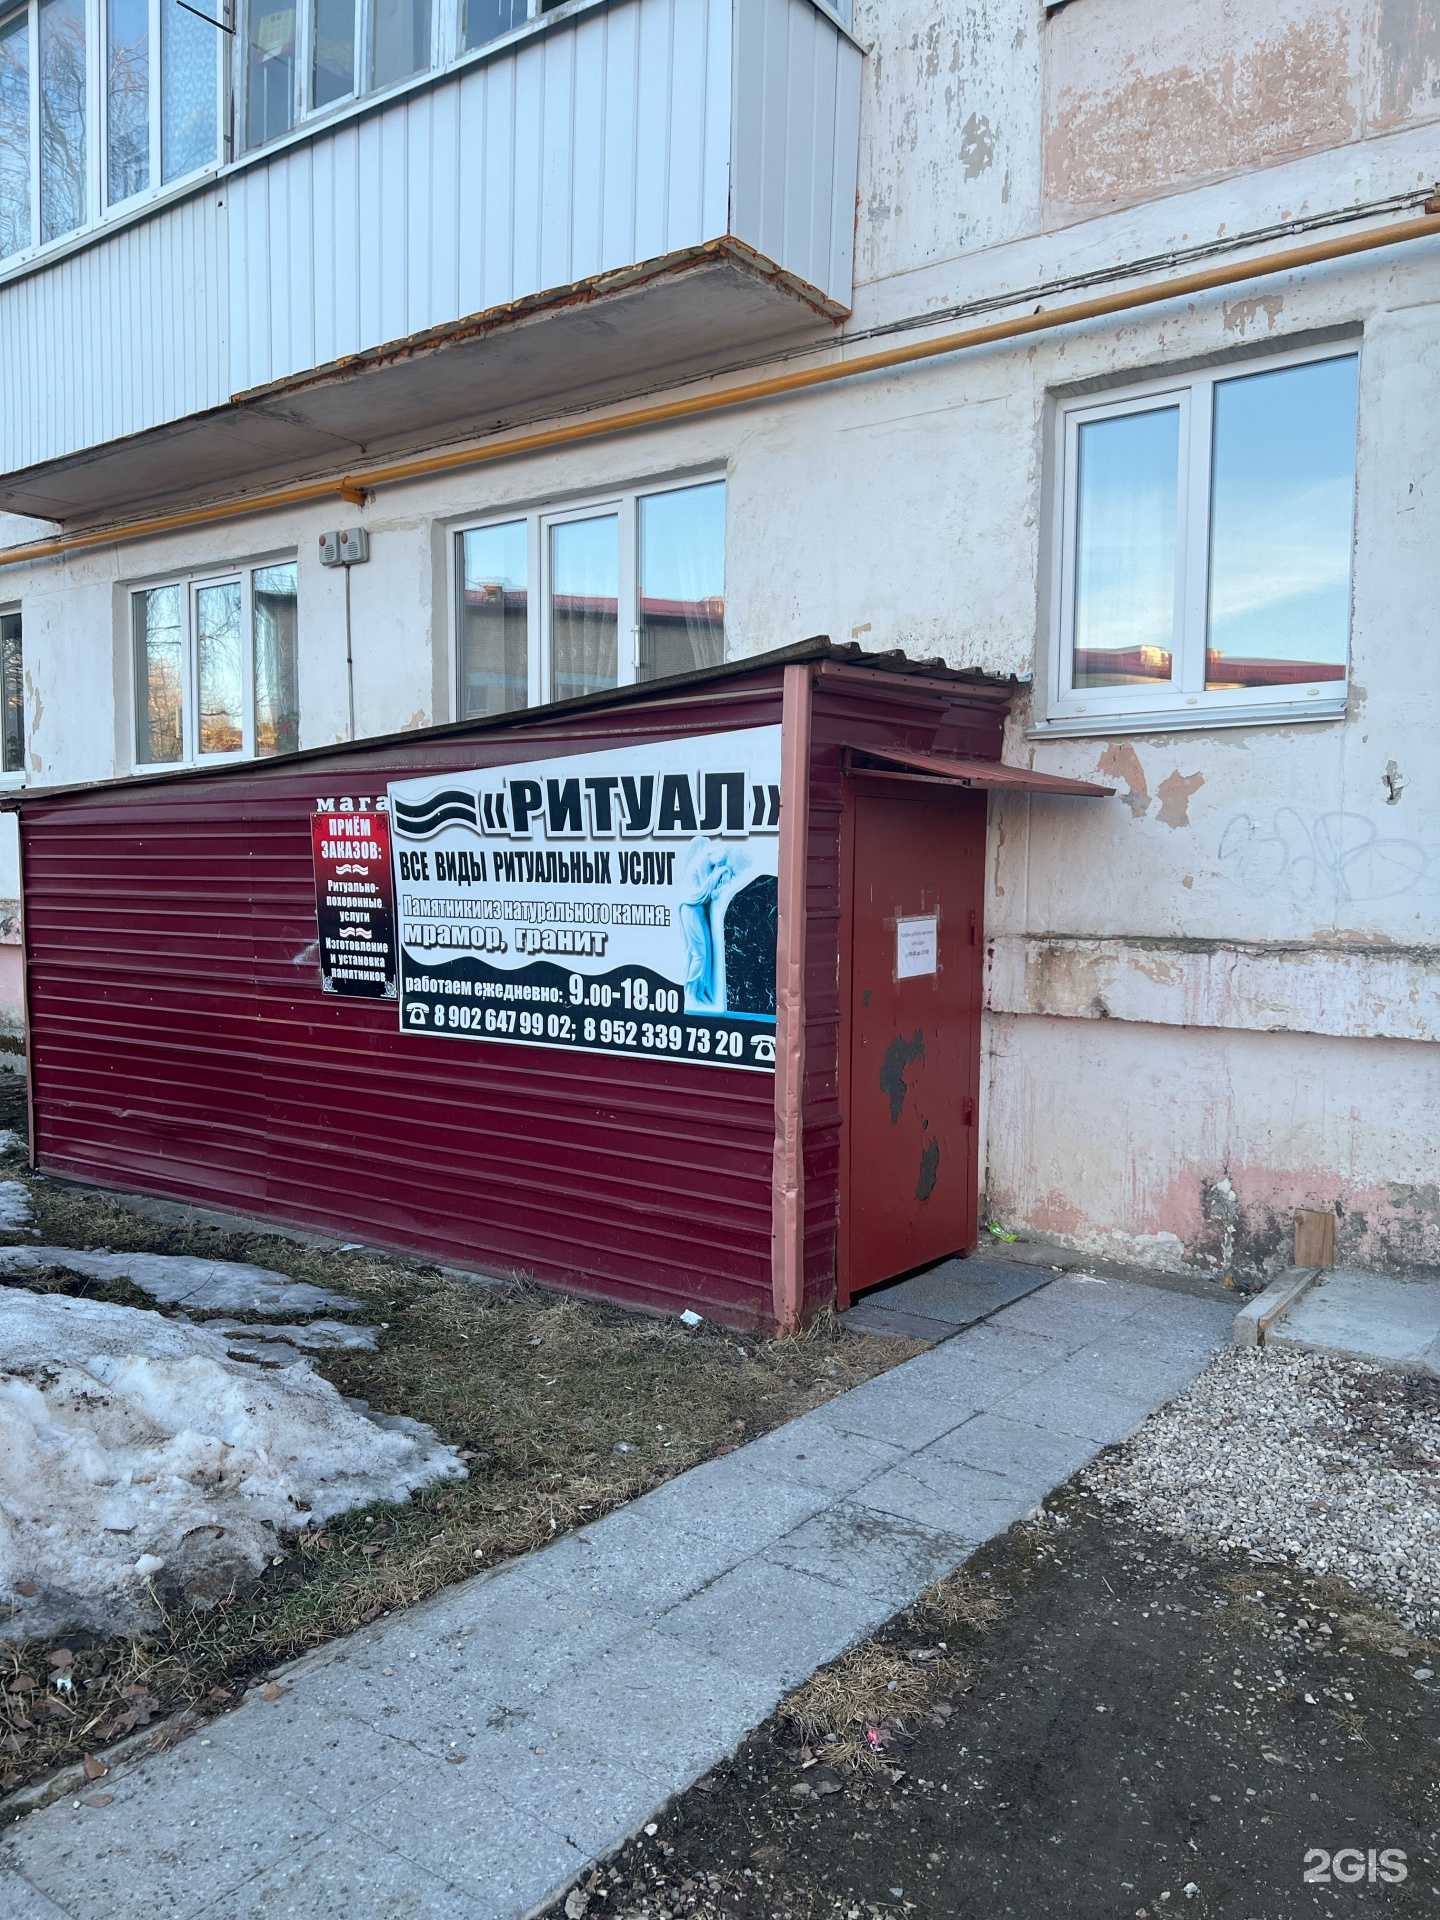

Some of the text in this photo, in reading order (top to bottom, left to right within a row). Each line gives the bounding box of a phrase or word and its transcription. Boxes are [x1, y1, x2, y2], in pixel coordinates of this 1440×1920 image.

[328, 816, 371, 837] ПРИЁМ
[321, 840, 382, 859] ЗАКАЗОВ:
[400, 851, 676, 887] ВСЕ ВИДЫ РИТУАЛЬНЫХ УСЛУГ
[327, 879, 380, 894] Ритуально-
[326, 895, 383, 909] похоронные
[402, 895, 671, 927] Памятники из натурального камня:
[339, 911, 371, 923] услуги
[325, 937, 389, 954] Изготовление
[403, 924, 608, 956] мрамор, гранит
[330, 953, 386, 968] и установка
[331, 967, 386, 982] памятников
[405, 974, 679, 1013] работаем ежедневно: 9.00-18.00
[434, 1004, 744, 1058] 8 902 647 99 02; 8 952 339 73 20
